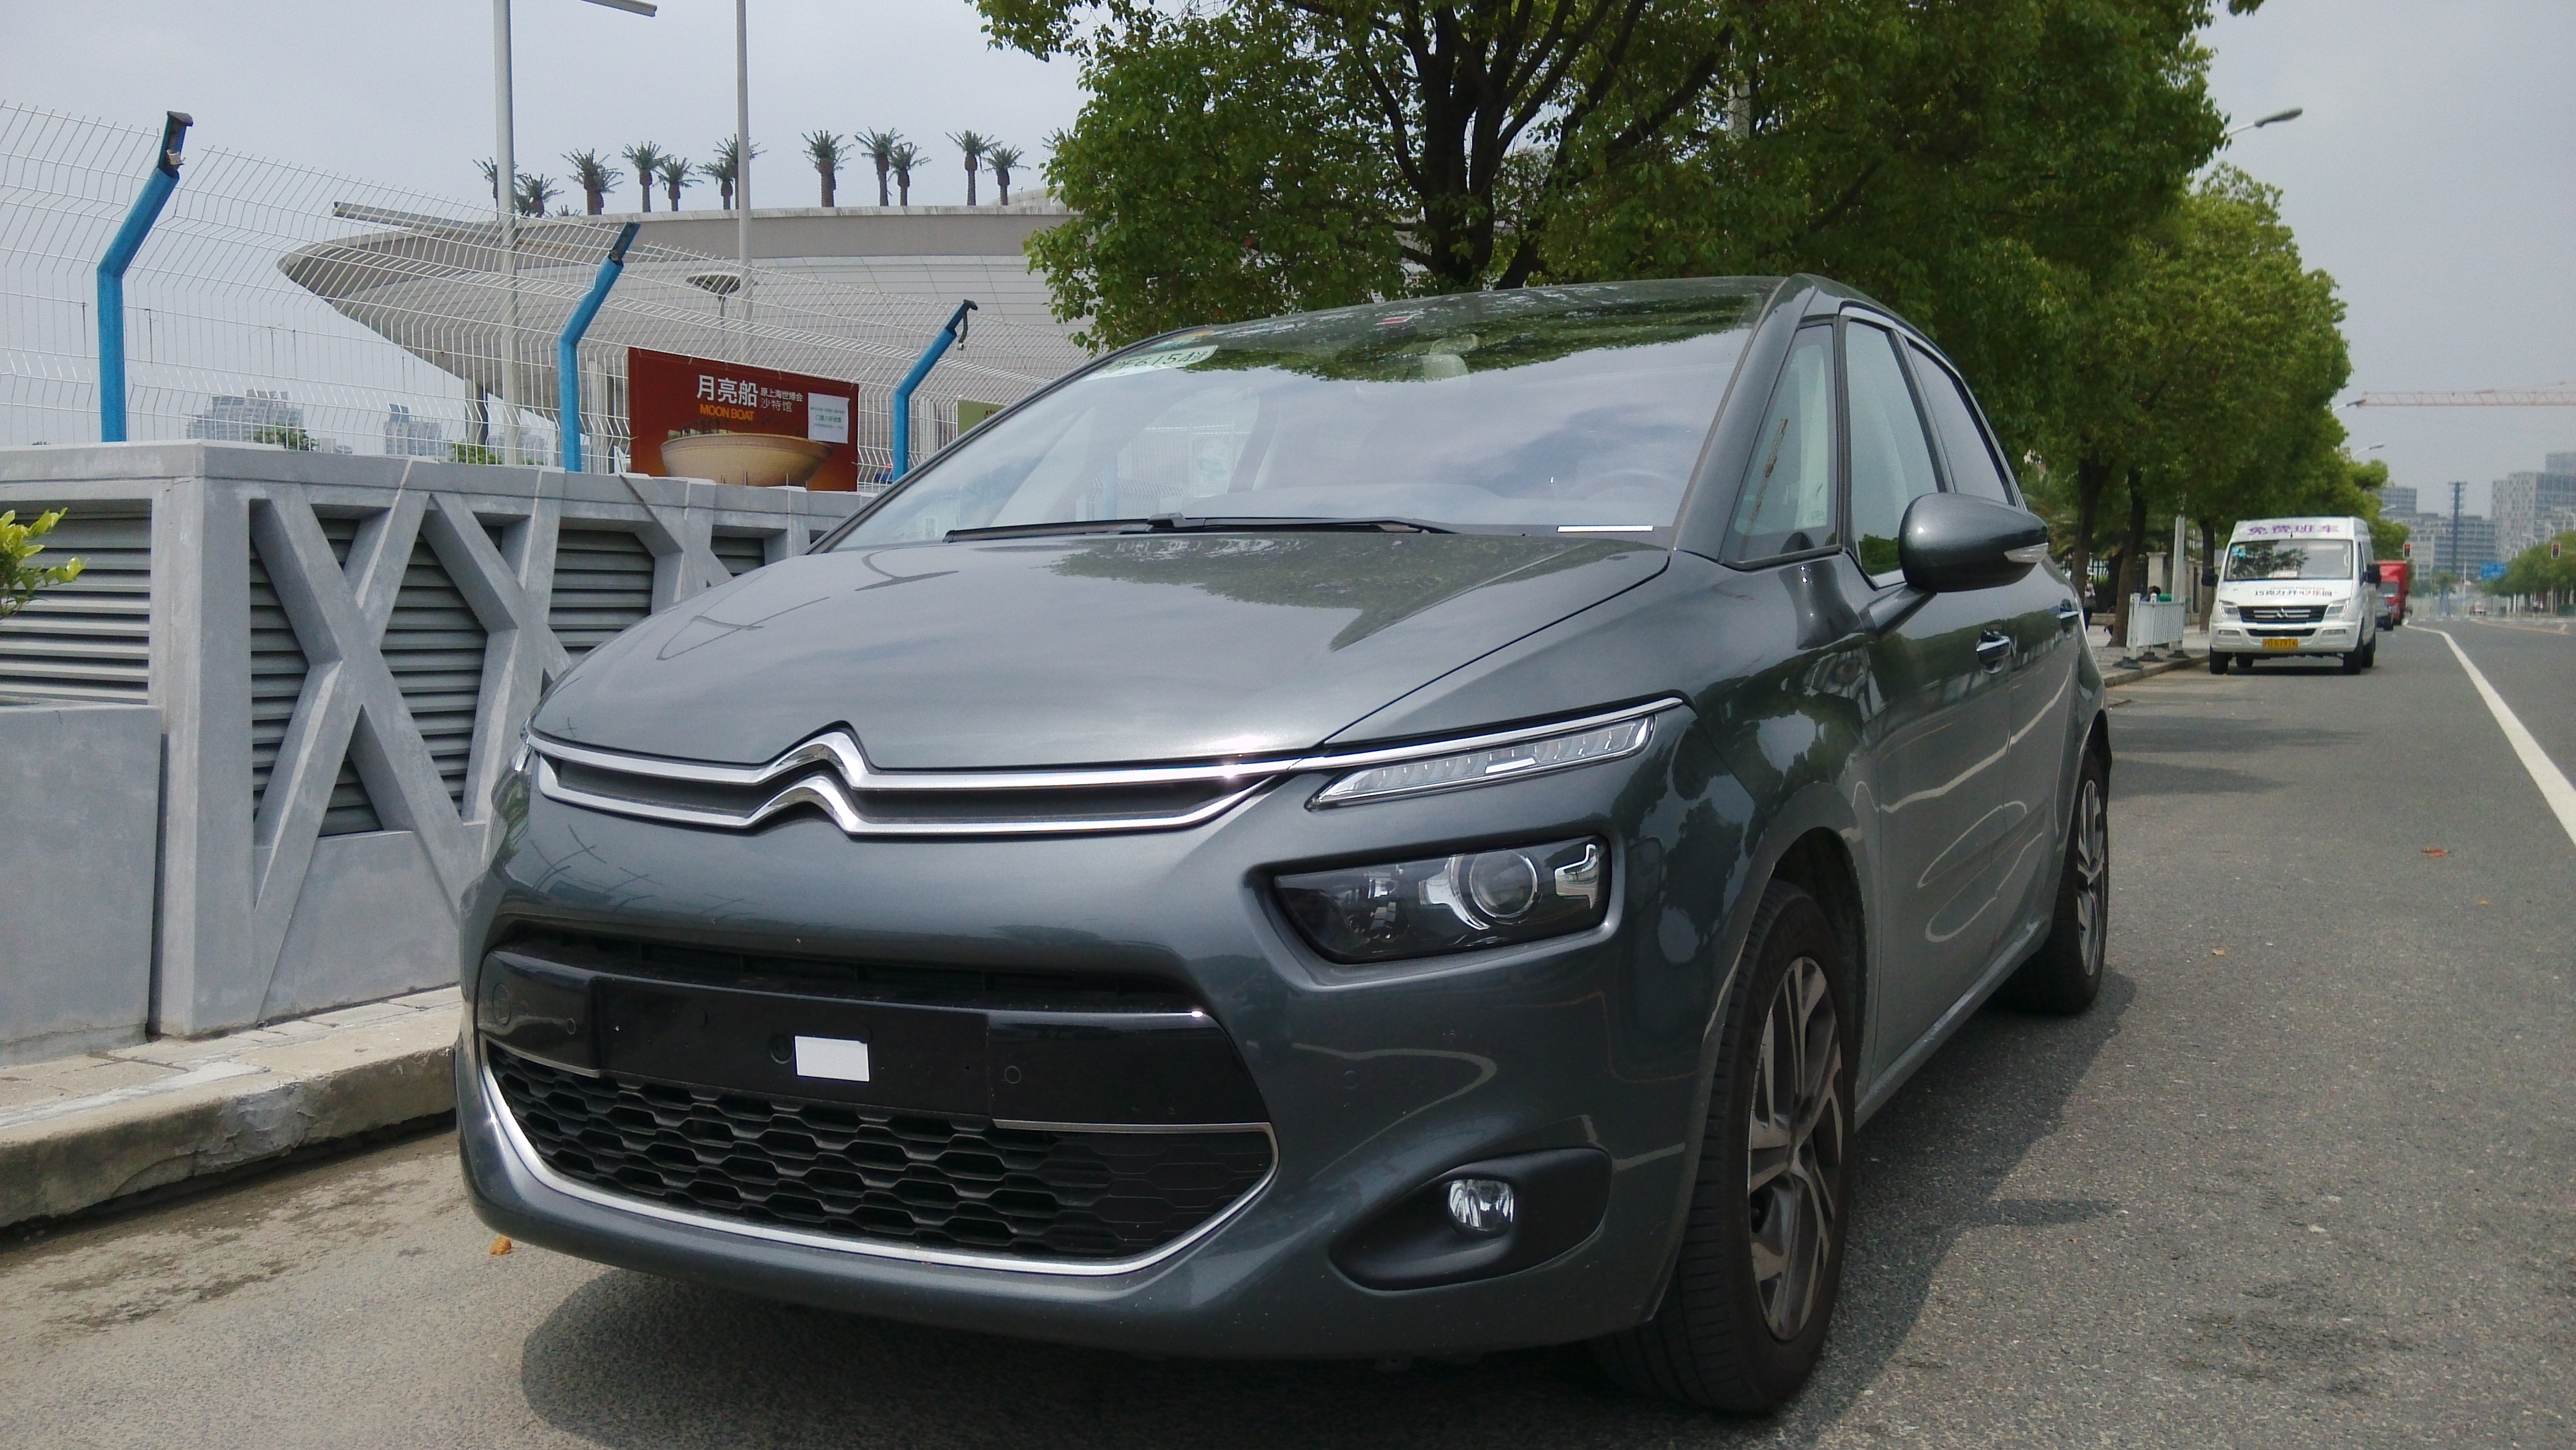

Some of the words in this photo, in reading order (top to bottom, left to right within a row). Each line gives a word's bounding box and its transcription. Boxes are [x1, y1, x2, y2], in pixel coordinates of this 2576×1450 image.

[696, 375, 758, 408] 月亮船
[760, 387, 804, 402] 原上海世博会
[760, 397, 793, 412] 沙特馆
[700, 404, 728, 419] MOON
[731, 408, 755, 421] BOAT
[2247, 525, 2339, 536] 免费班车
